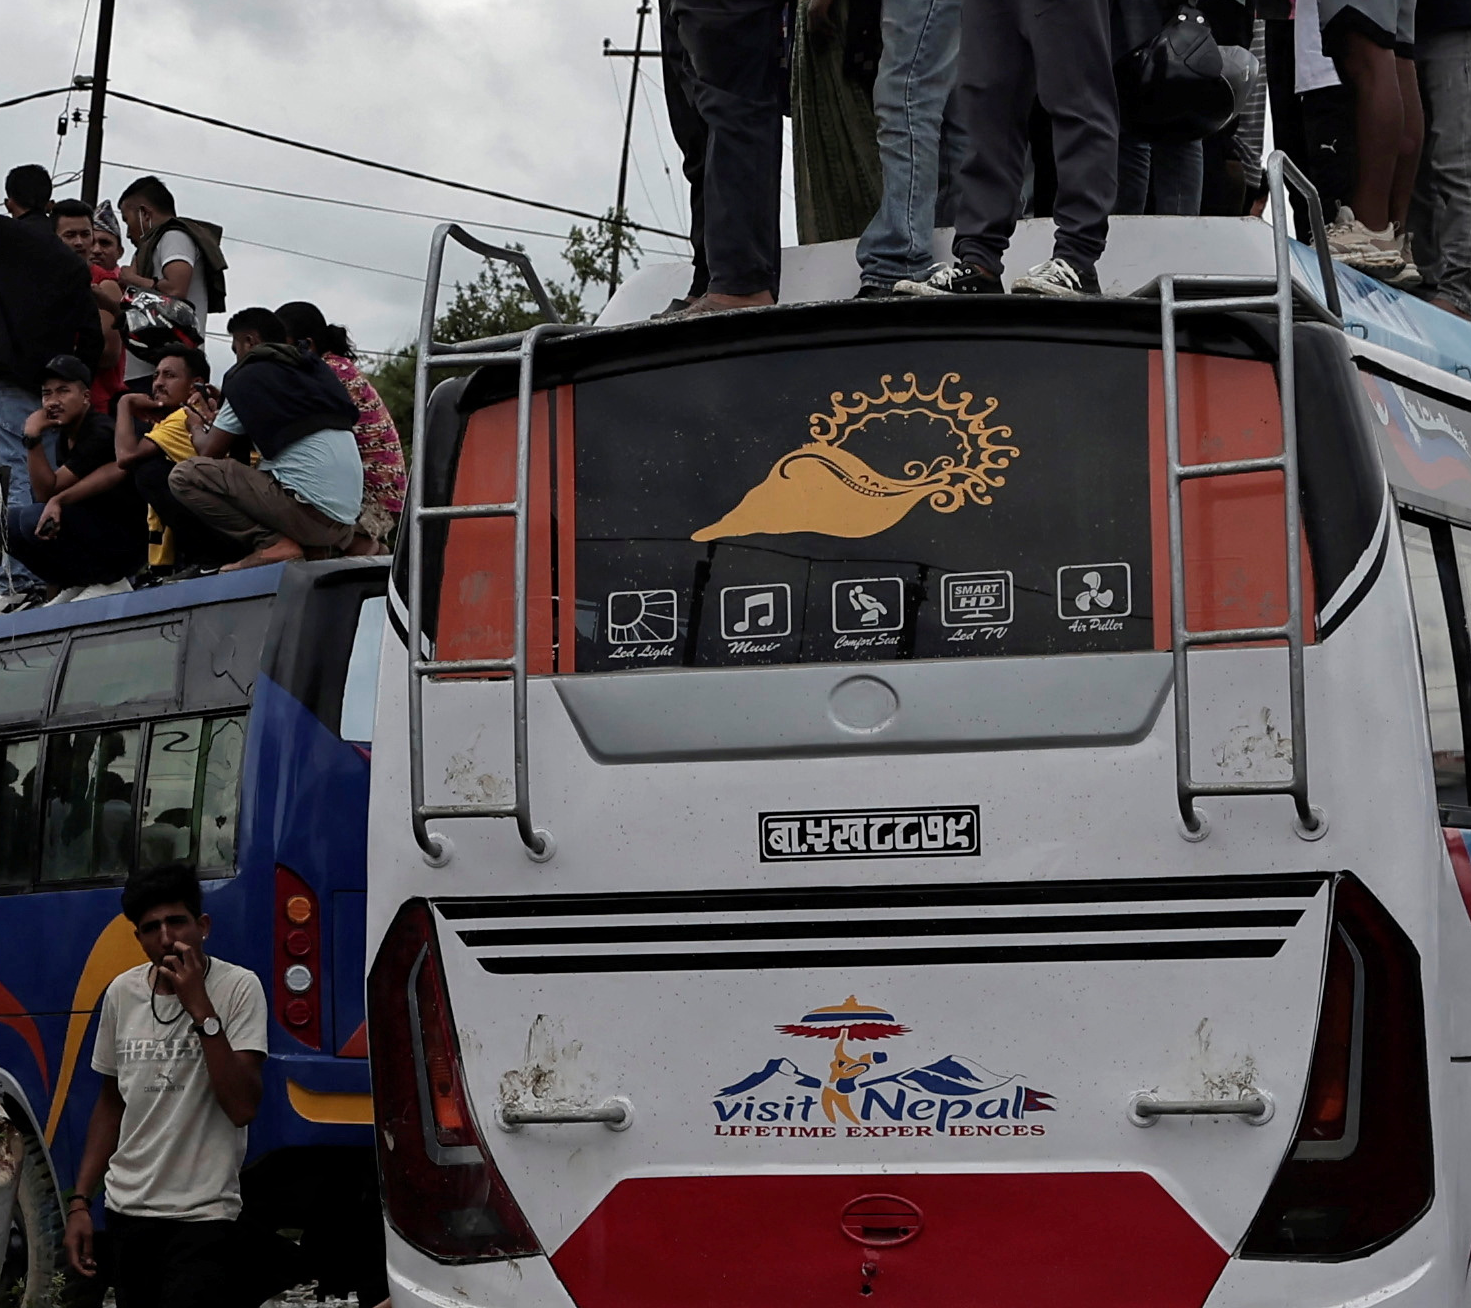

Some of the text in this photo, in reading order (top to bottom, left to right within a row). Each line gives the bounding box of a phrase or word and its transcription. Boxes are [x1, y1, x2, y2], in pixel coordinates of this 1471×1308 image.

[954, 583, 999, 595] SMART
[959, 596, 996, 607] HD
[1068, 617, 1124, 633] Air Puller
[834, 634, 900, 650] Comfort Seat
[947, 627, 1008, 642] Led TV
[609, 644, 674, 661] Led Light
[129, 1038, 202, 1060] ITALY
[713, 1086, 1023, 1132] visit Nepal
[714, 1124, 836, 1138] LIFETIME
